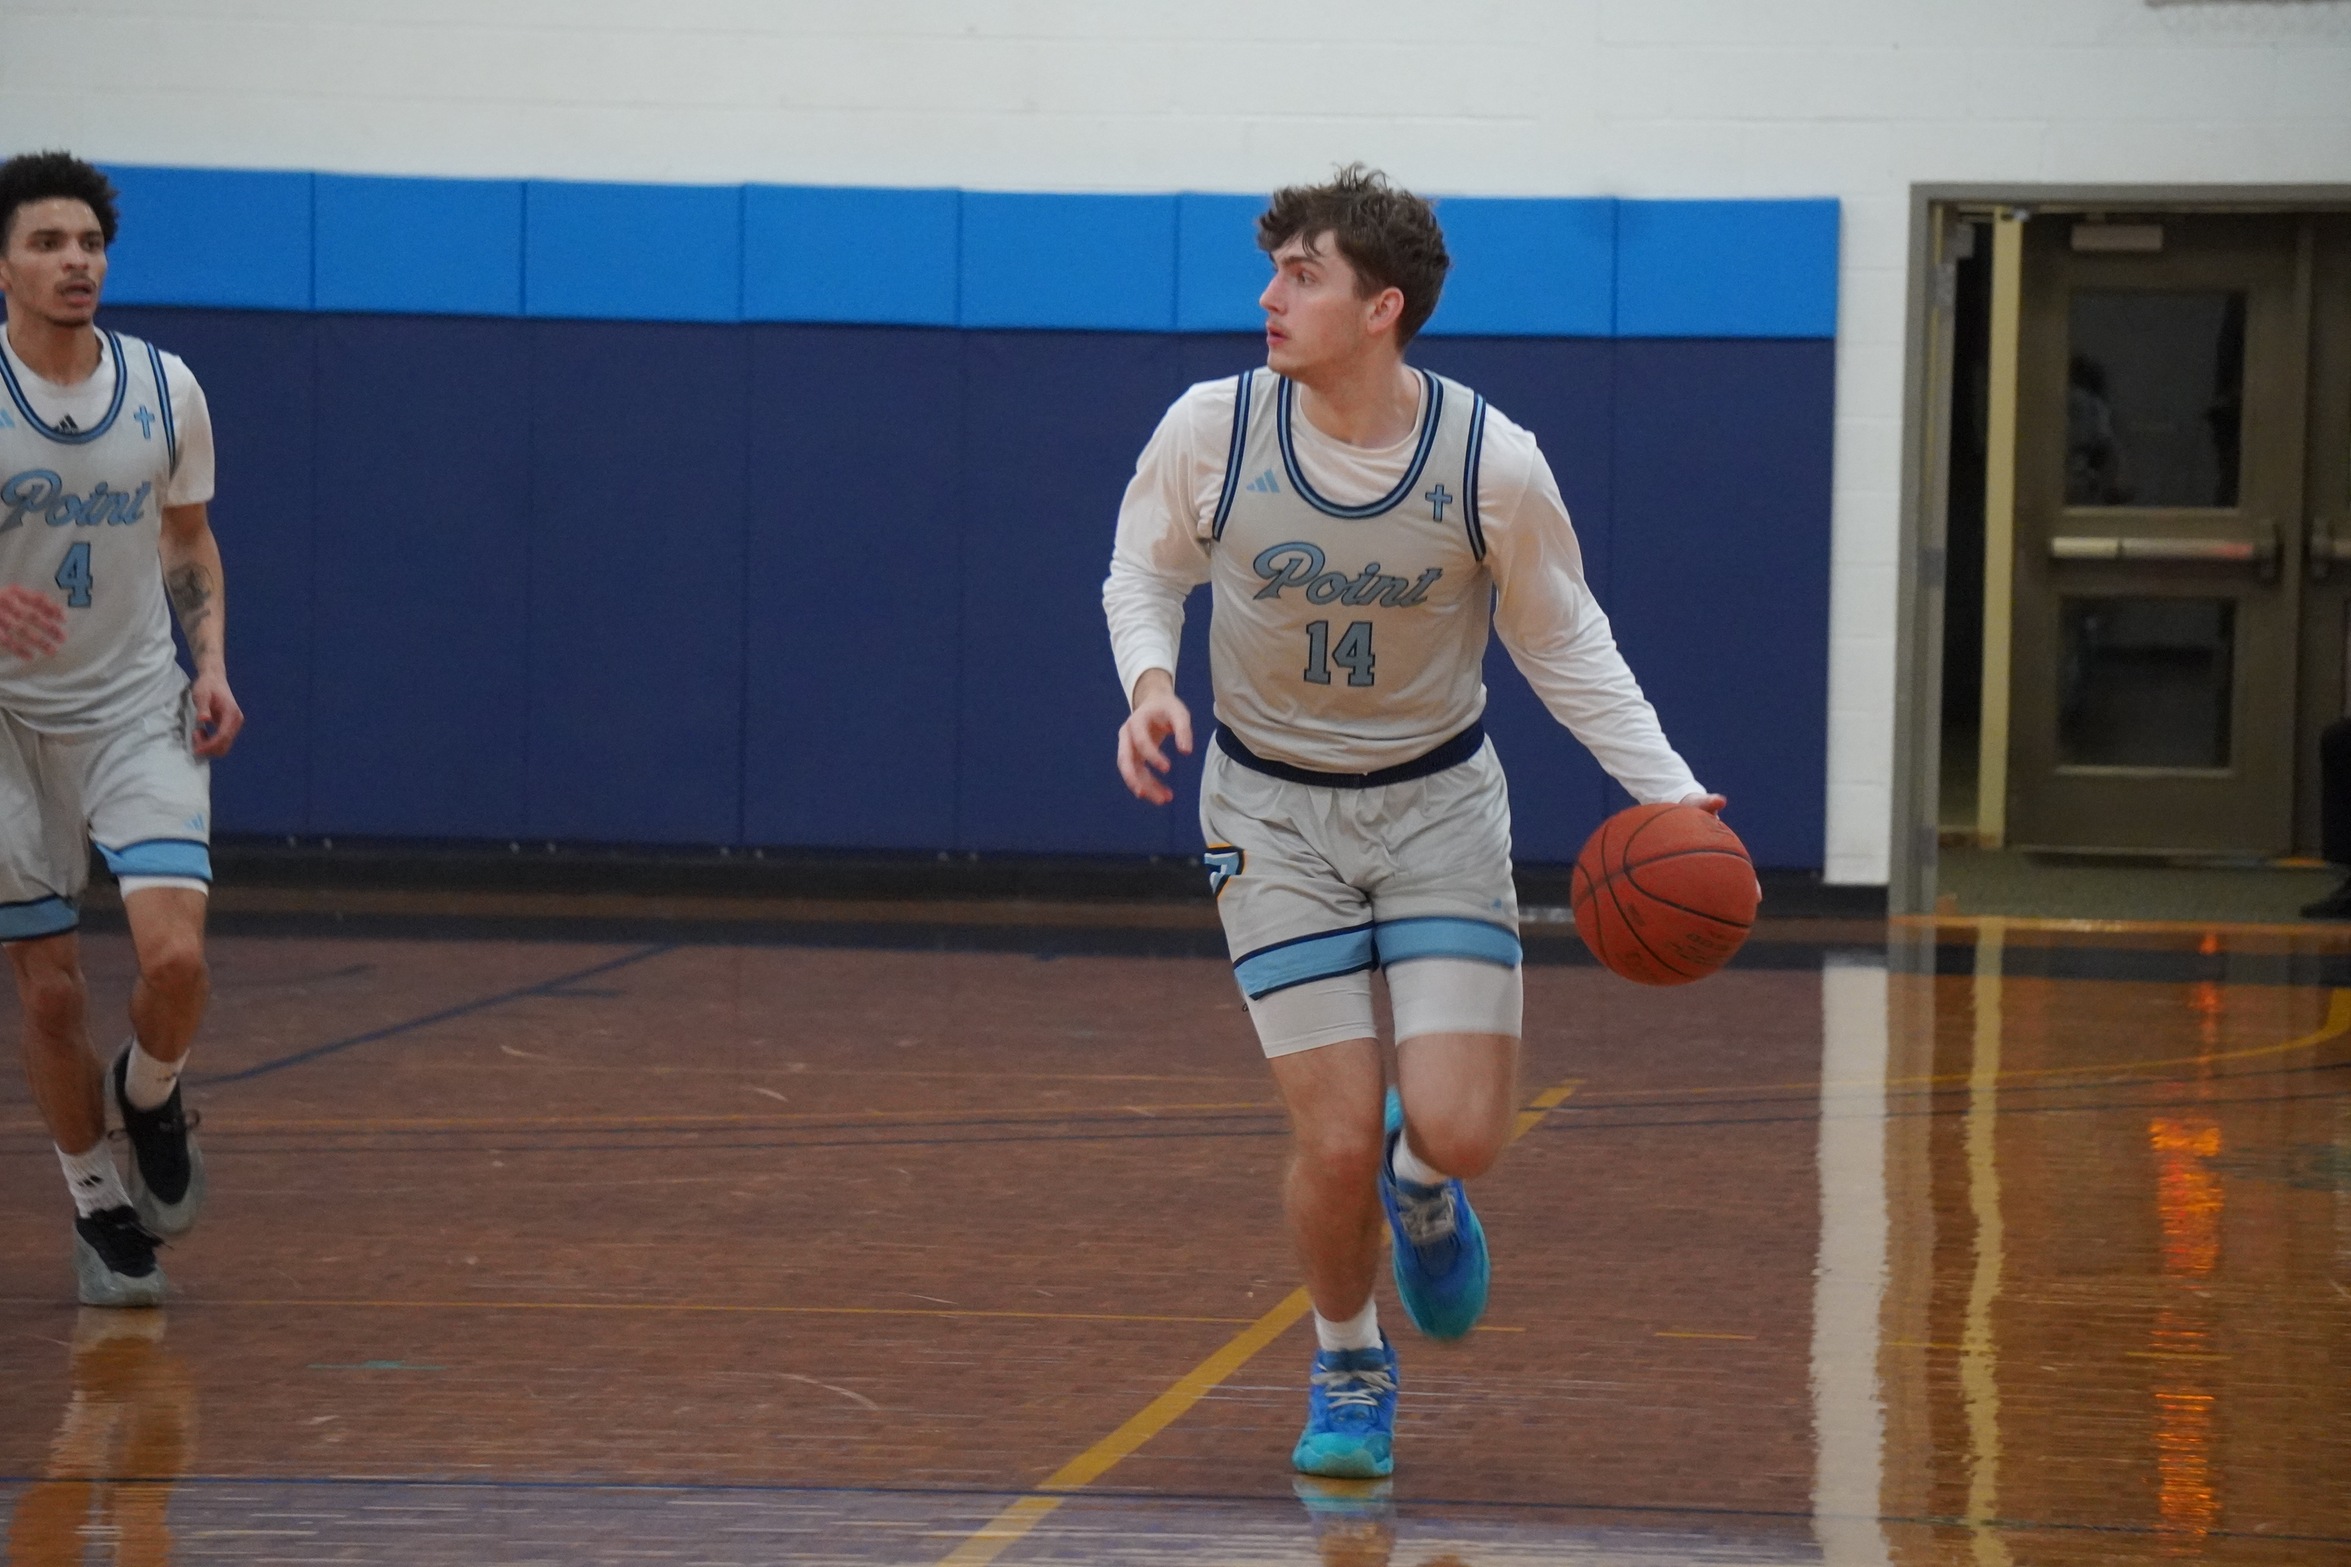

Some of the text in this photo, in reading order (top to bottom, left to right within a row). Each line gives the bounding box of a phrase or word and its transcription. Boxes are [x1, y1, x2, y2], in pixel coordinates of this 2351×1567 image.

[0, 468, 151, 533] Point
[54, 540, 93, 608] 4
[1252, 540, 1444, 608] Point
[1303, 619, 1376, 687] 14
